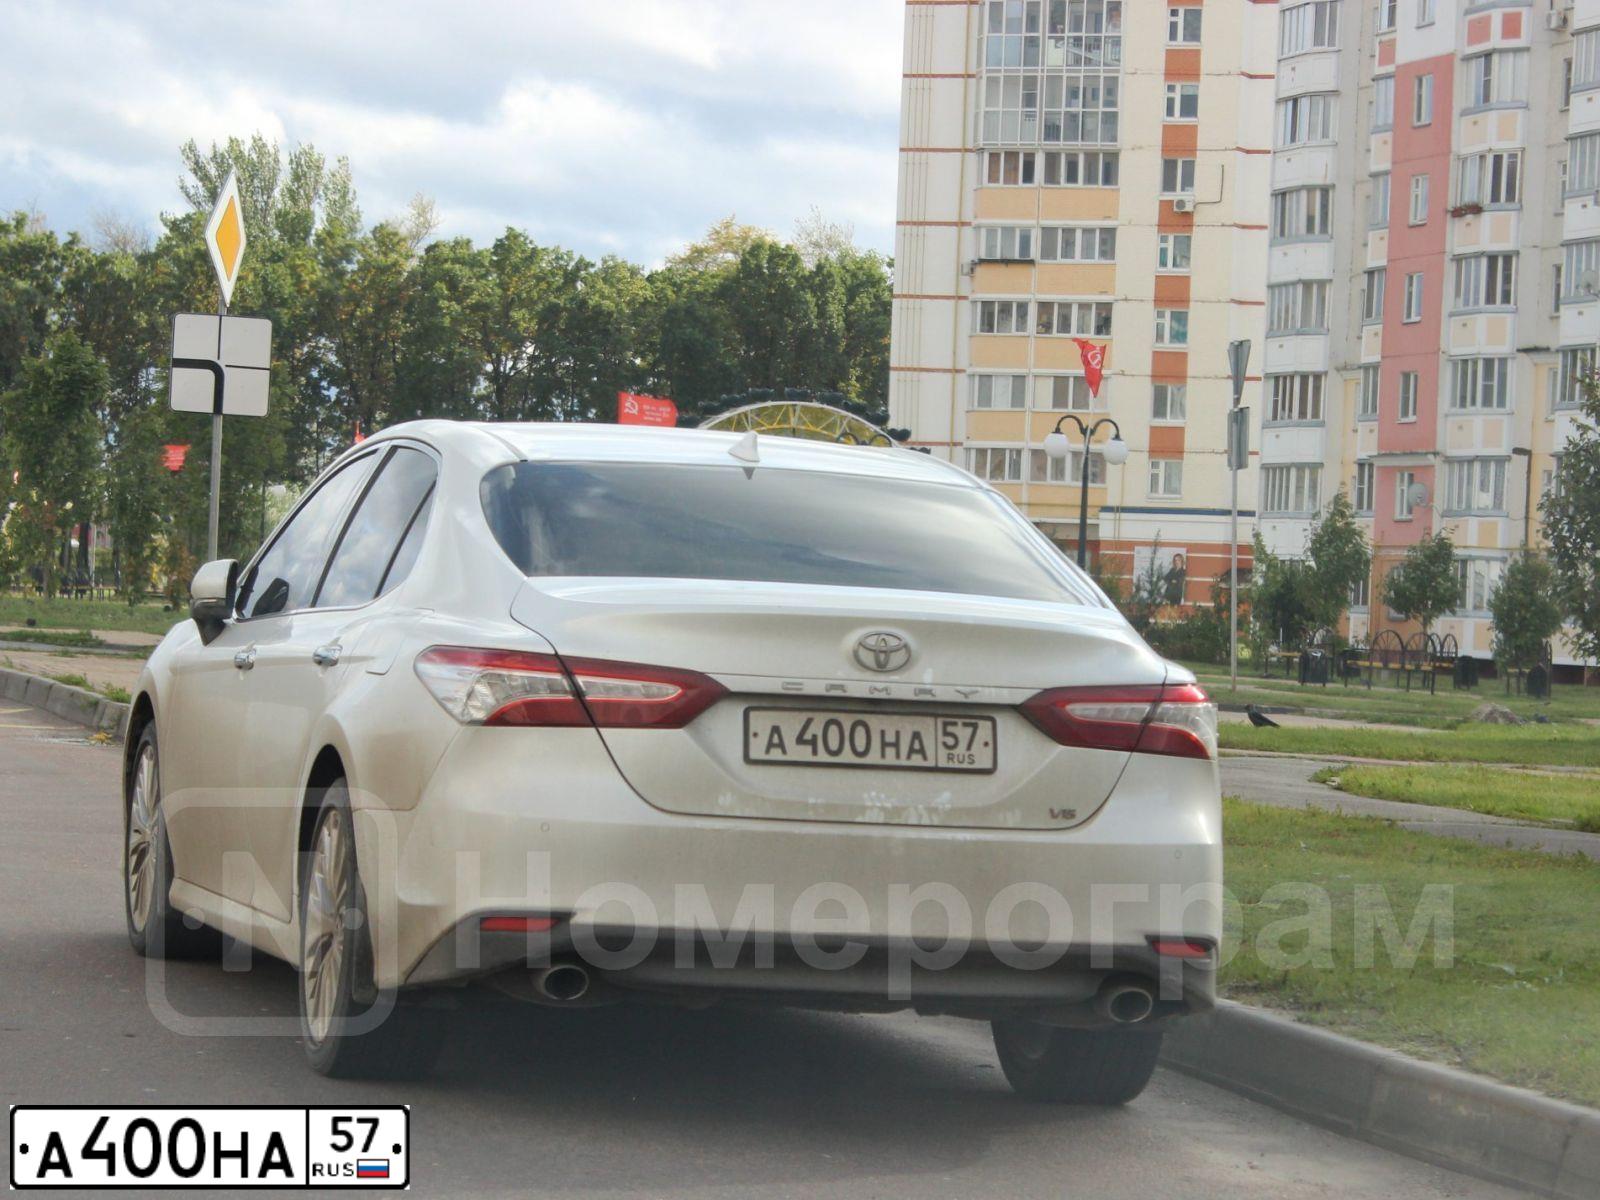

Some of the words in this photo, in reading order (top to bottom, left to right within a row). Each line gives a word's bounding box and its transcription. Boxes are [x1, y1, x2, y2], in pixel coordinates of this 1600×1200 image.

[781, 681, 980, 699] CAMRY
[941, 721, 980, 752] 57
[946, 752, 976, 766] RUS
